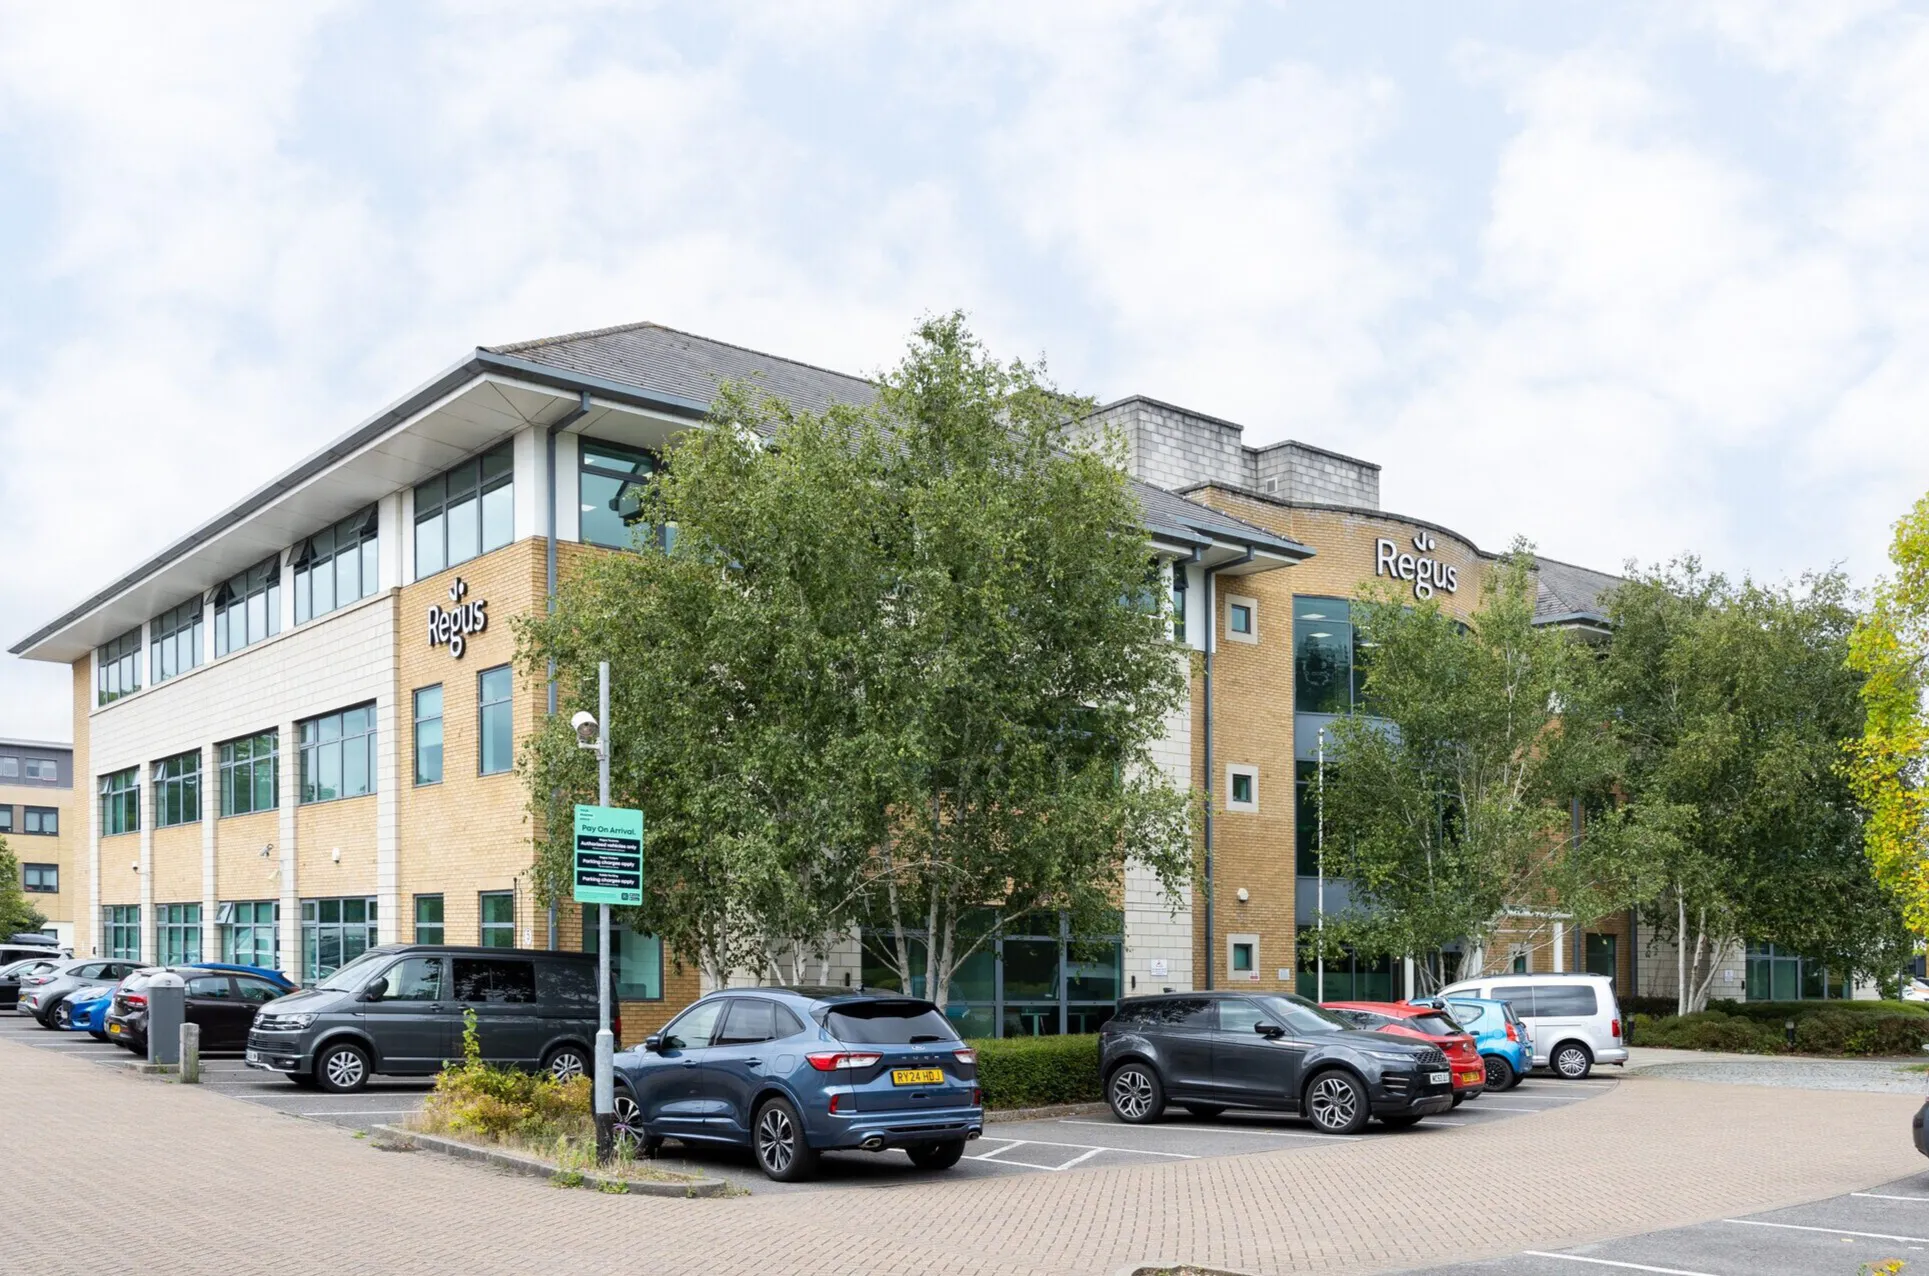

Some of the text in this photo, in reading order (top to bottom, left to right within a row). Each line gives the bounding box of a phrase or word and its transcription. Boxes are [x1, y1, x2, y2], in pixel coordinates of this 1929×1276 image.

[1376, 537, 1457, 601] Regus
[428, 600, 488, 659] Regus
[582, 824, 596, 833] Pay
[610, 827, 636, 836] Arrival.
[897, 1071, 920, 1082] RY24
